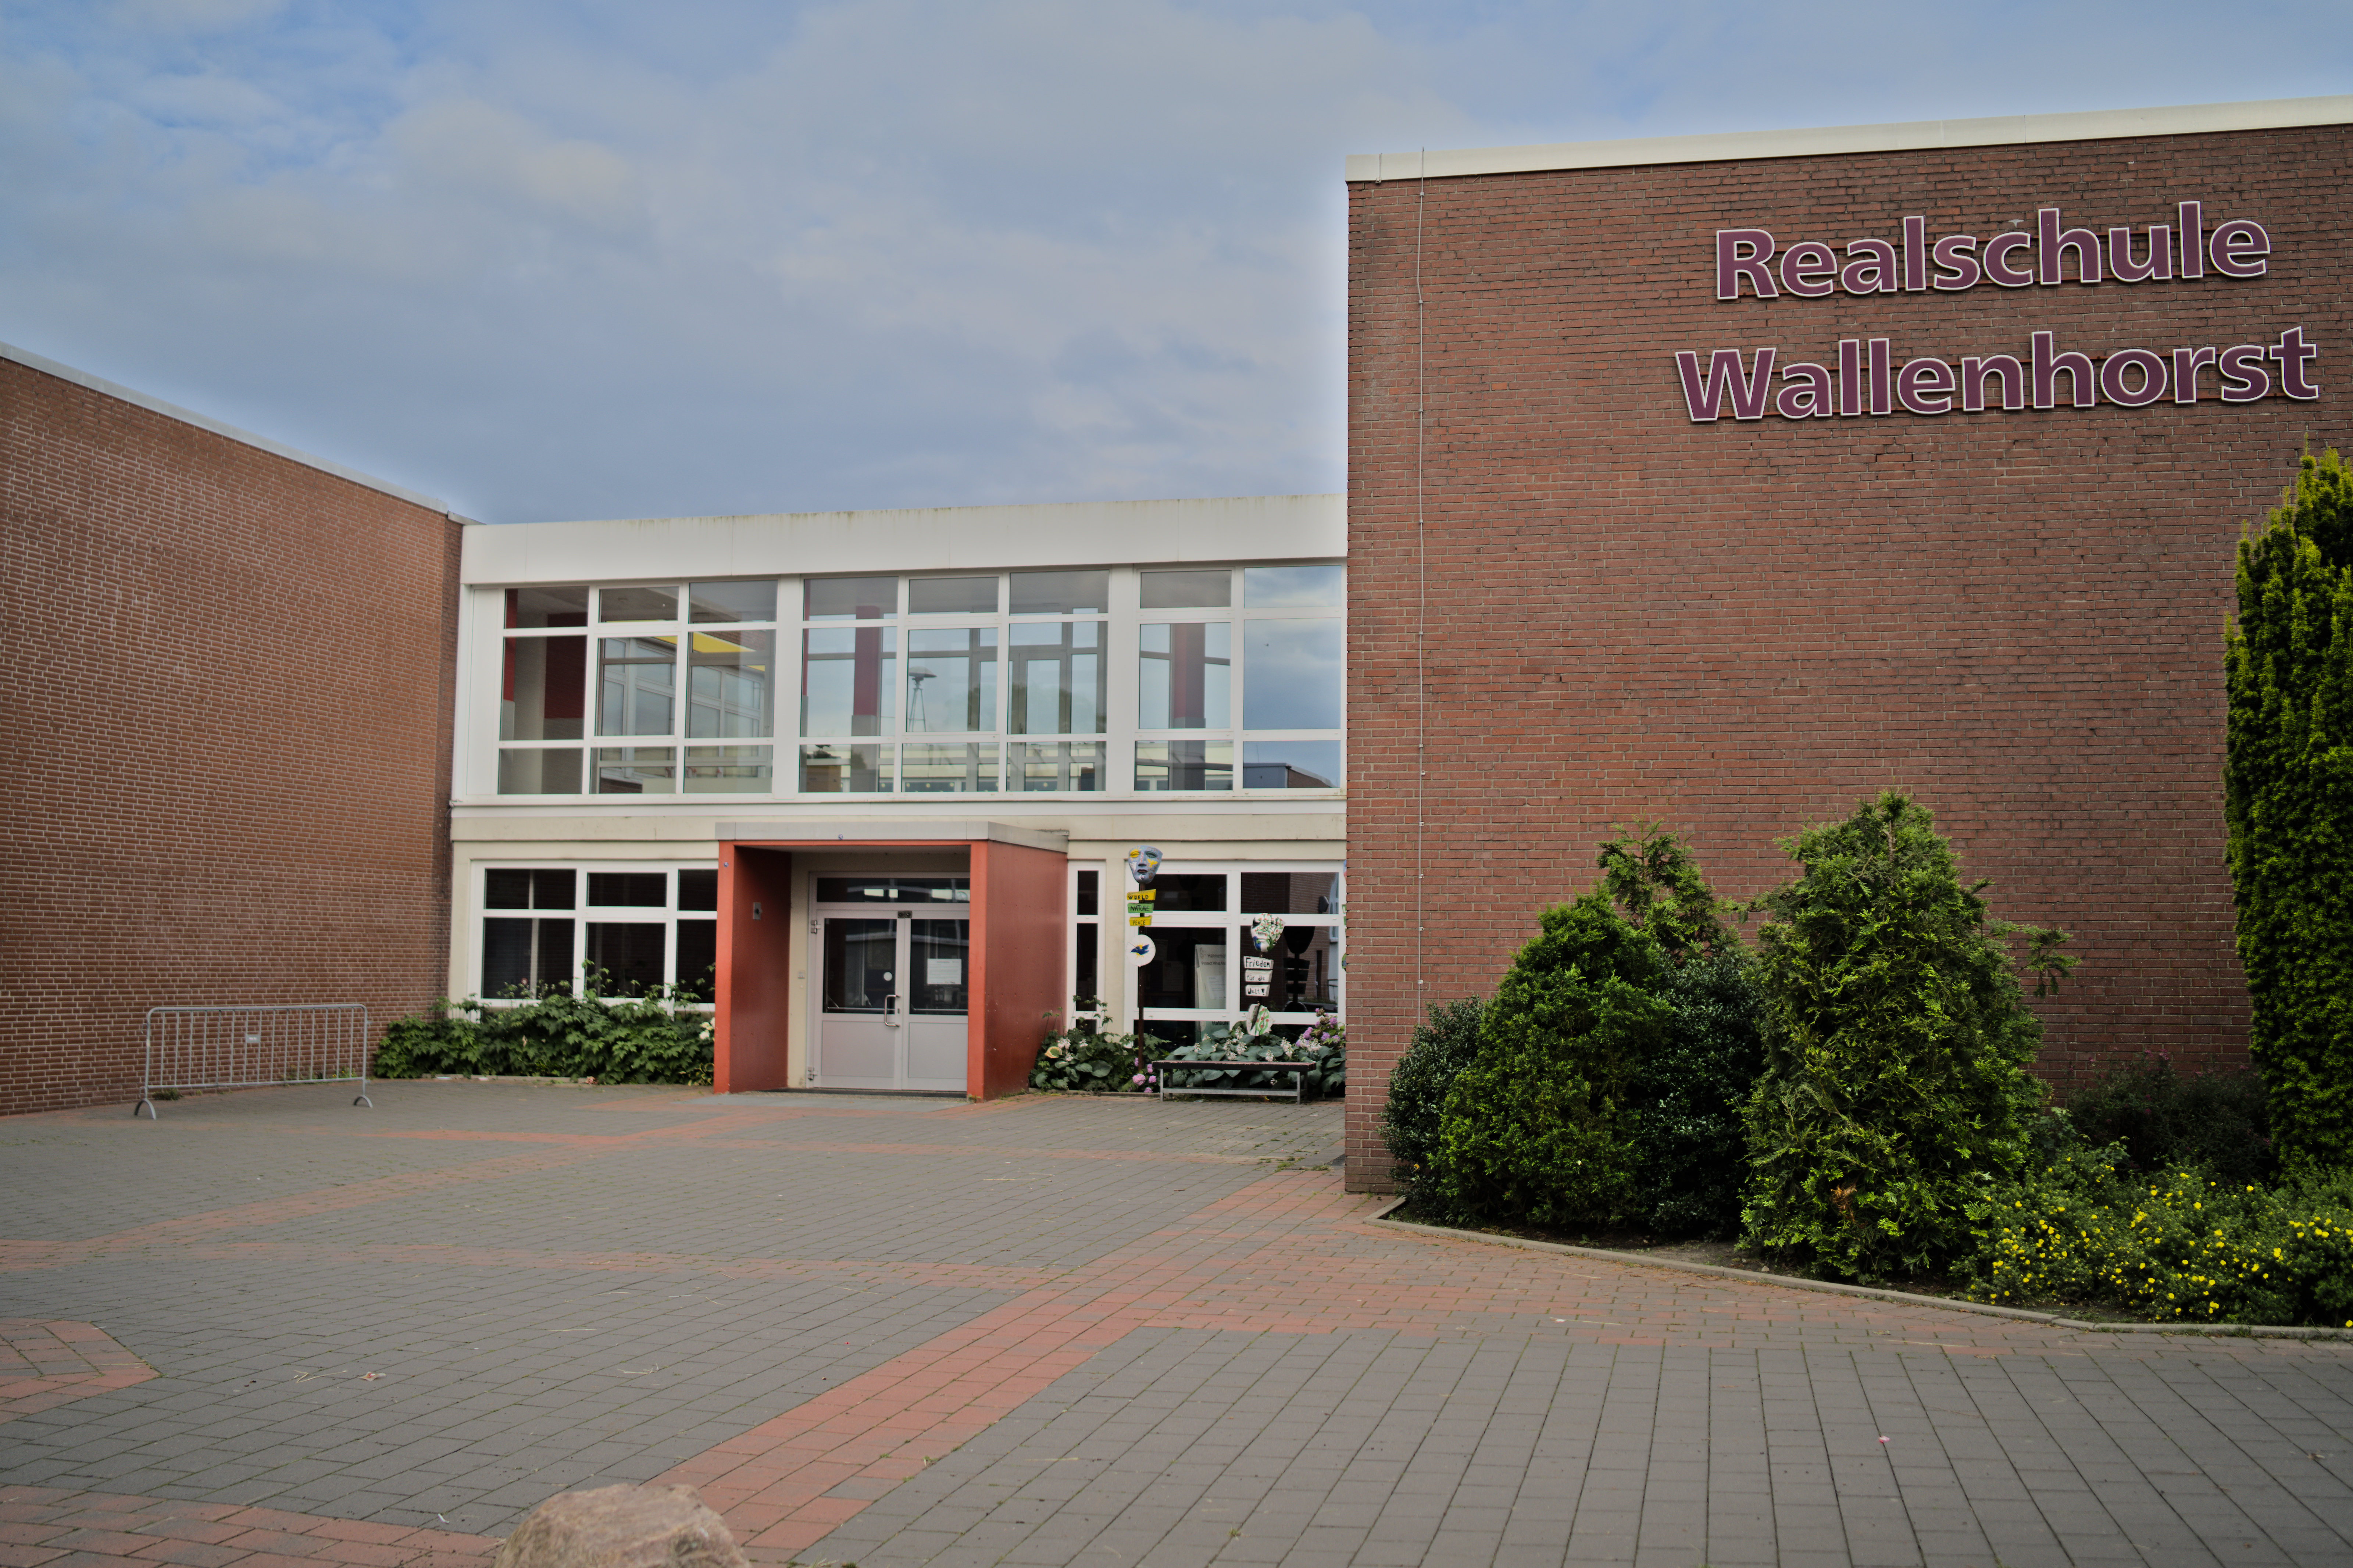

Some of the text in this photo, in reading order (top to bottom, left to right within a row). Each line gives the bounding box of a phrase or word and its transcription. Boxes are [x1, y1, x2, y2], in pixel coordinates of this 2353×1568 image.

[1716, 201, 2271, 300] Realschule
[1675, 326, 2319, 421] Wallenhorst
[1246, 957, 1270, 968] Frieden
